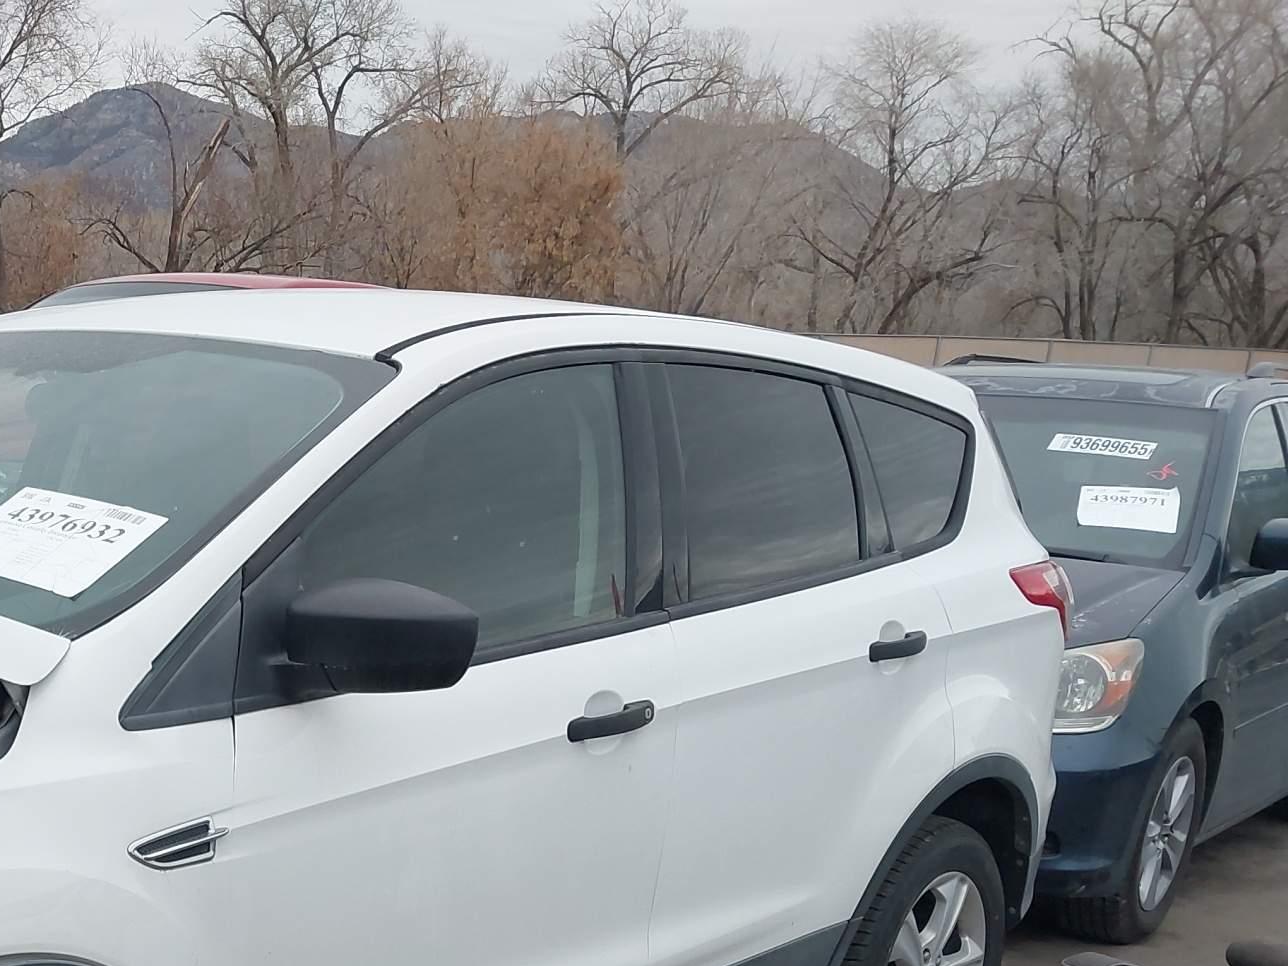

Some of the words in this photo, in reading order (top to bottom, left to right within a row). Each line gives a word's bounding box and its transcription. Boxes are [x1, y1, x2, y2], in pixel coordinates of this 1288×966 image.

[1071, 436, 1149, 456] 93699655
[1089, 494, 1166, 506] 43987971
[8, 506, 126, 543] 43976932
